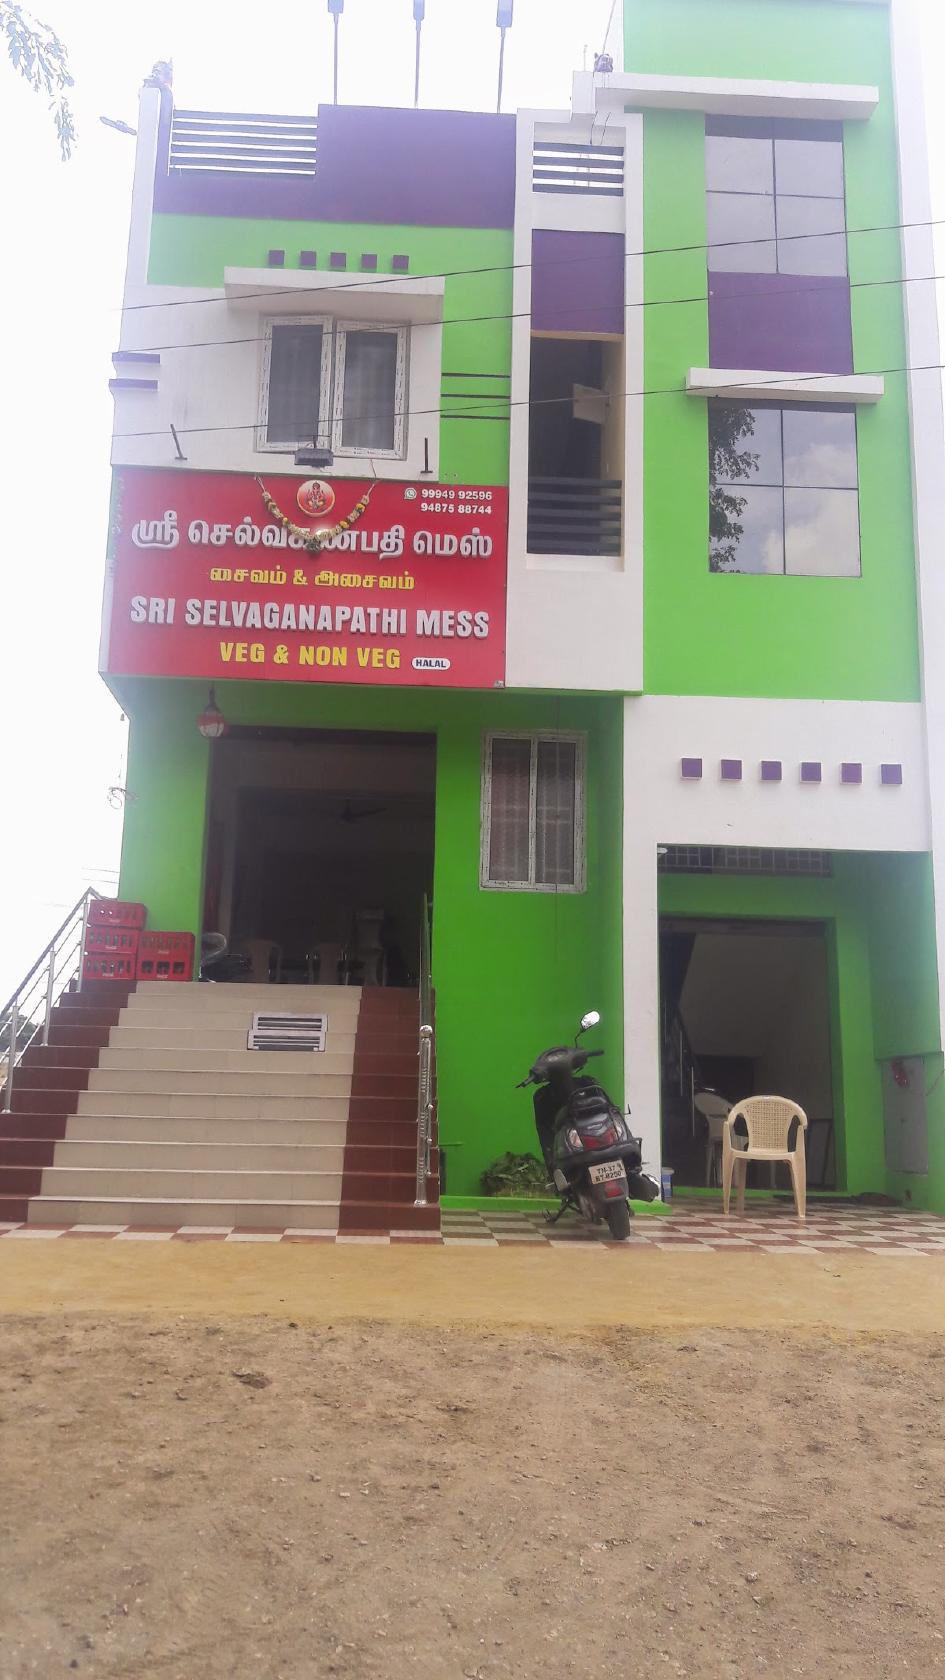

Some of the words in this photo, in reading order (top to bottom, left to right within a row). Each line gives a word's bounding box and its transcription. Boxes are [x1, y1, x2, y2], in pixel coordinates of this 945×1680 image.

[421, 488, 455, 499] 99949
[458, 490, 492, 500] 92596
[421, 502, 455, 513] 94875
[458, 504, 492, 514] 88744
[413, 527, 494, 558] மெஸ்
[210, 565, 288, 586] சைவம்
[293, 569, 308, 586] &
[315, 570, 416, 590] அசைவம்
[130, 596, 175, 625] SRI
[185, 598, 407, 635] SELVAGANAPATHI
[415, 610, 490, 639] MESS
[219, 642, 265, 664] VEG
[273, 645, 290, 665] &
[299, 646, 348, 667] NON
[357, 648, 401, 669] VEG
[415, 658, 447, 669] HALAL
